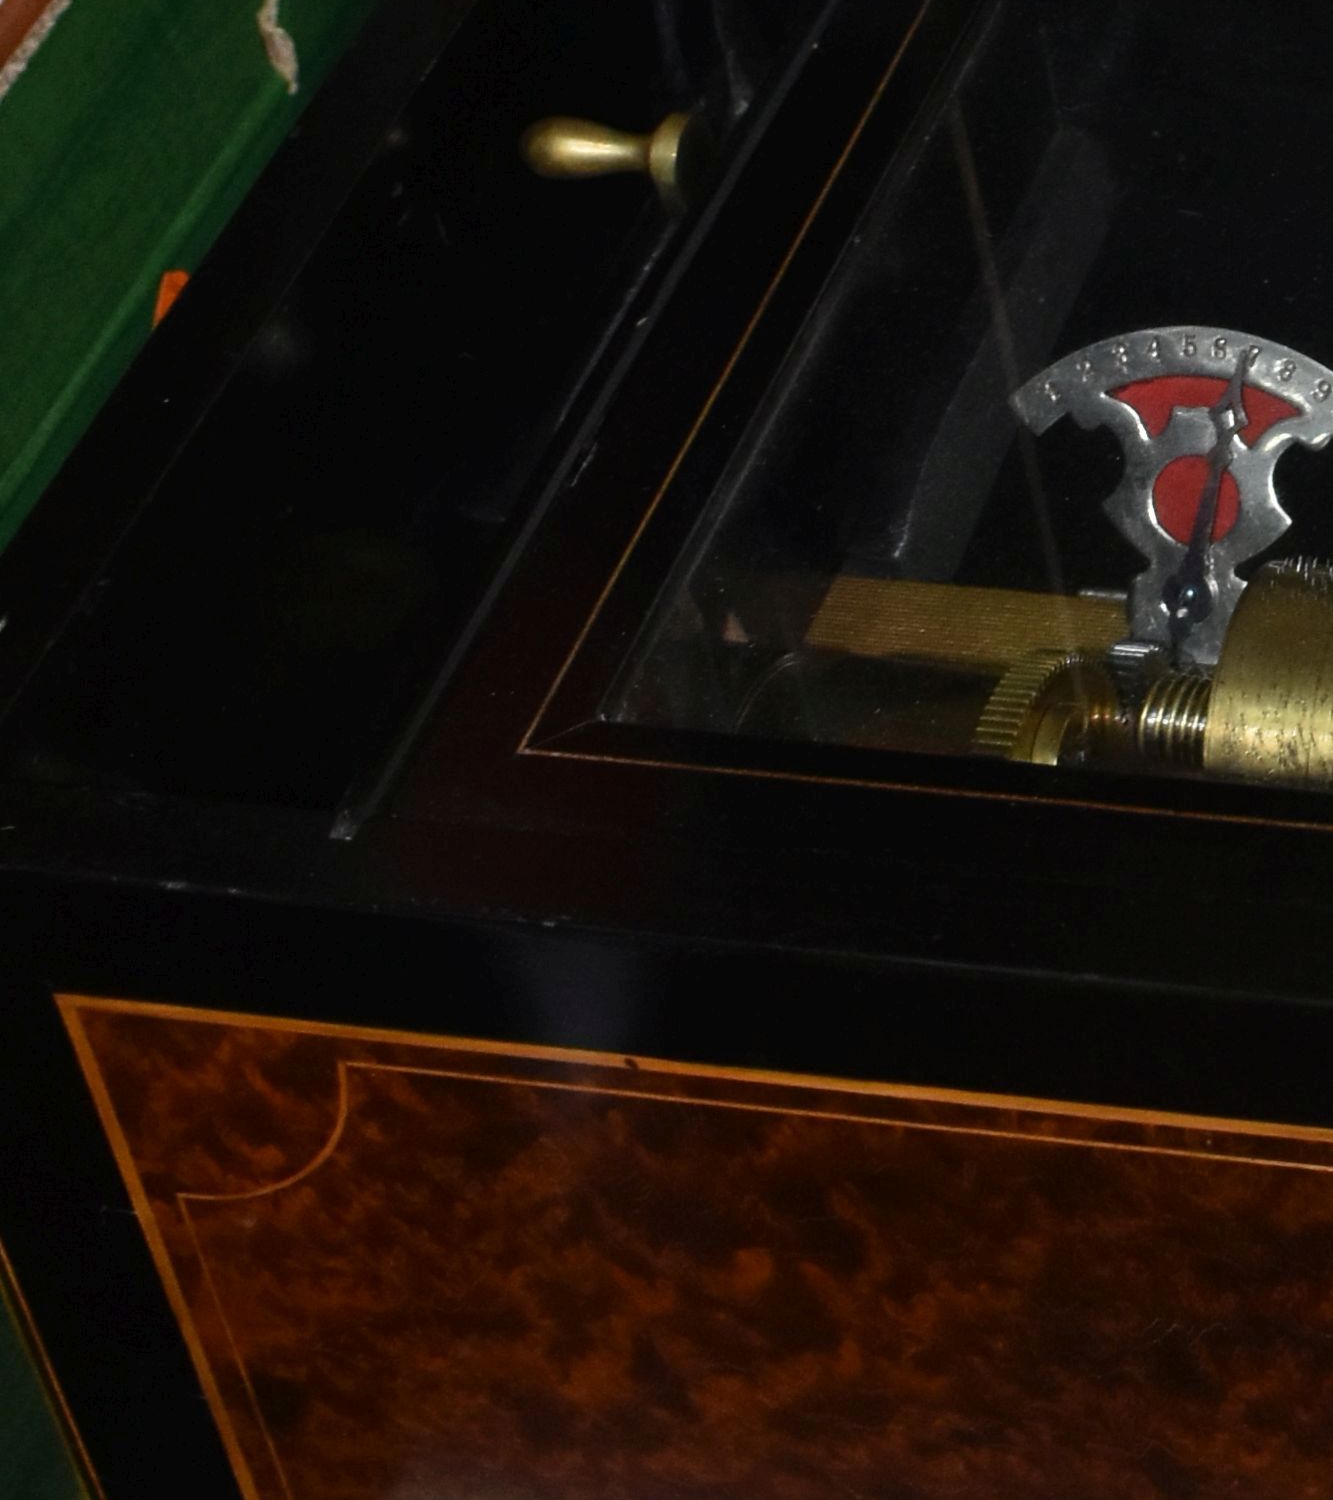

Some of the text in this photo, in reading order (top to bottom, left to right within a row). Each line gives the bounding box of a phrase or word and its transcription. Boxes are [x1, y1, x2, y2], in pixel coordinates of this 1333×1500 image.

[1044, 380, 1062, 401] 1
[1076, 360, 1095, 382] 2
[1112, 342, 1129, 374] 3
[1146, 337, 1162, 361] 4
[1181, 333, 1198, 358] 5
[1211, 336, 1228, 361] 6
[1277, 358, 1297, 381] 8
[1312, 378, 1333, 401] 9
